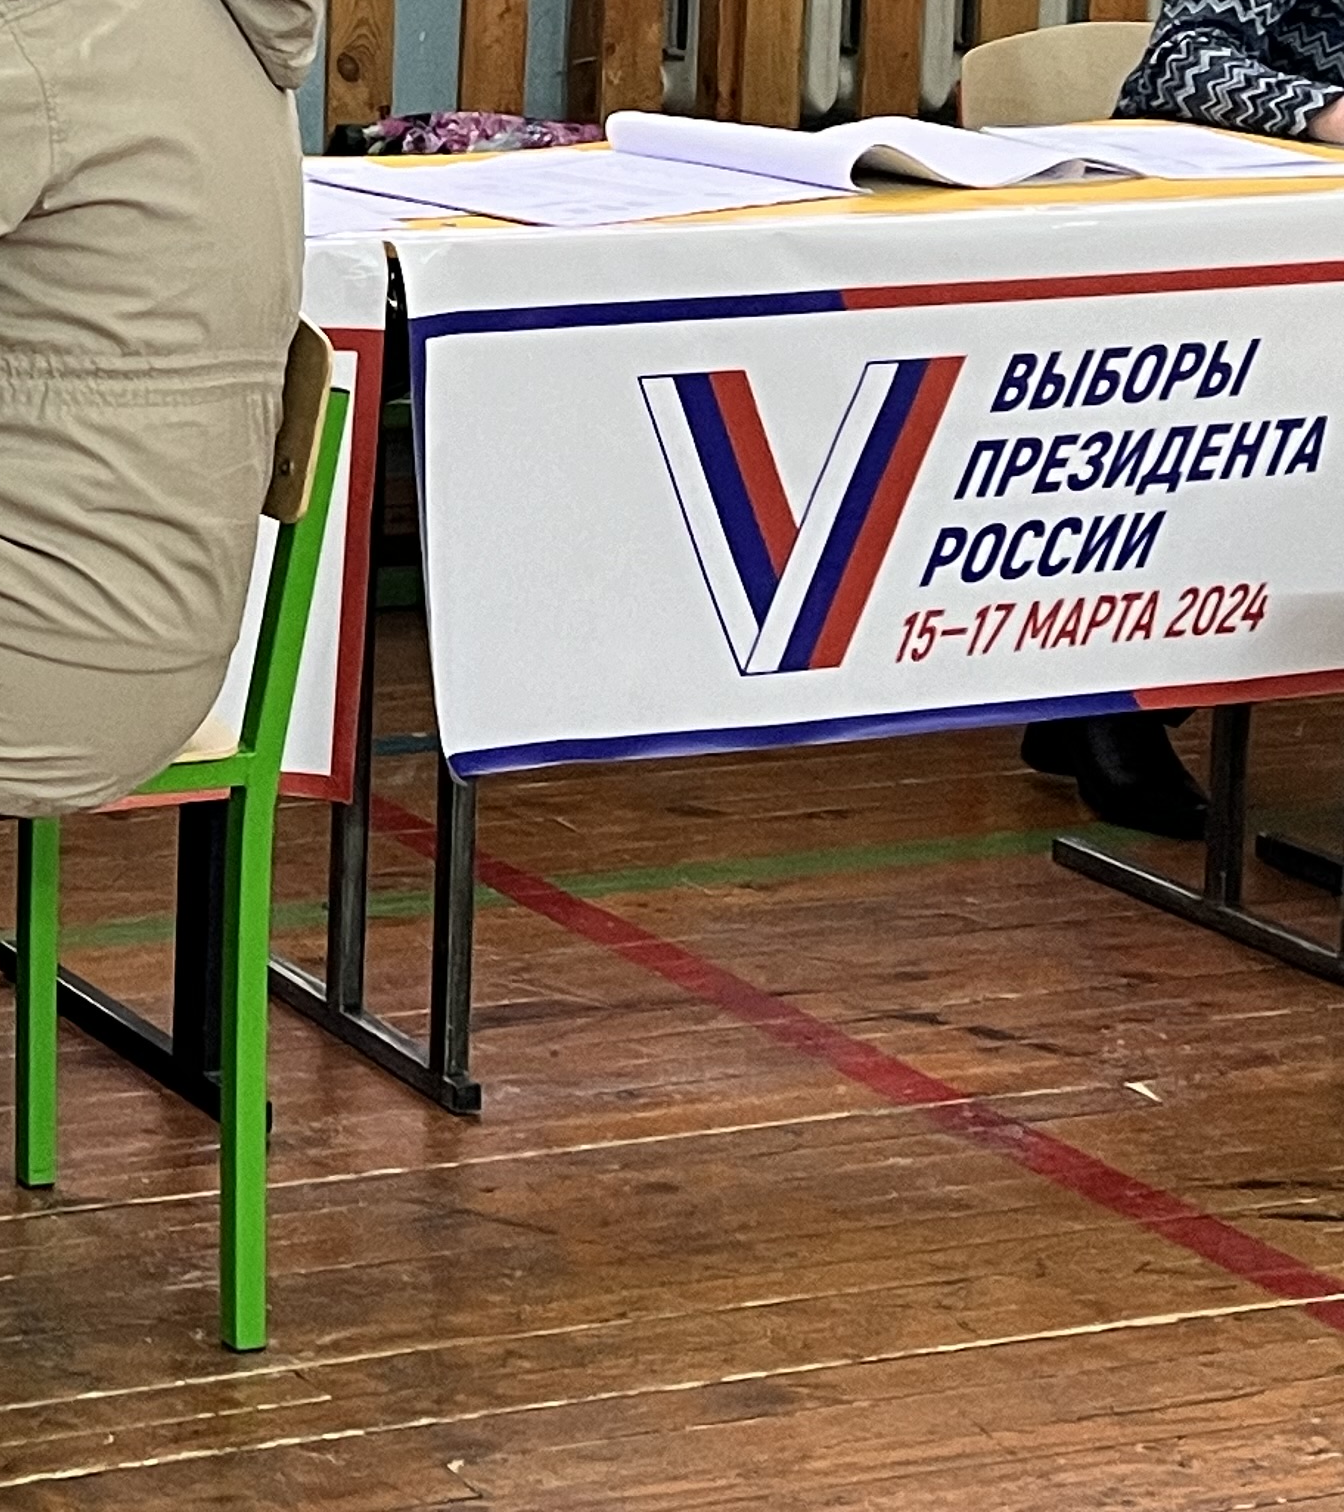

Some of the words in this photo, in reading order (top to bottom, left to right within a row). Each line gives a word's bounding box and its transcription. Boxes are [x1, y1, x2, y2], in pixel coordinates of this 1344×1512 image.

[989, 337, 1262, 414] ВЫБОРЫ
[952, 414, 1328, 501] ПРЕЗИДЕНТА
[918, 509, 1168, 589] РОССИИ
[1012, 589, 1161, 653] МАРТА
[1162, 581, 1269, 640] 2024
